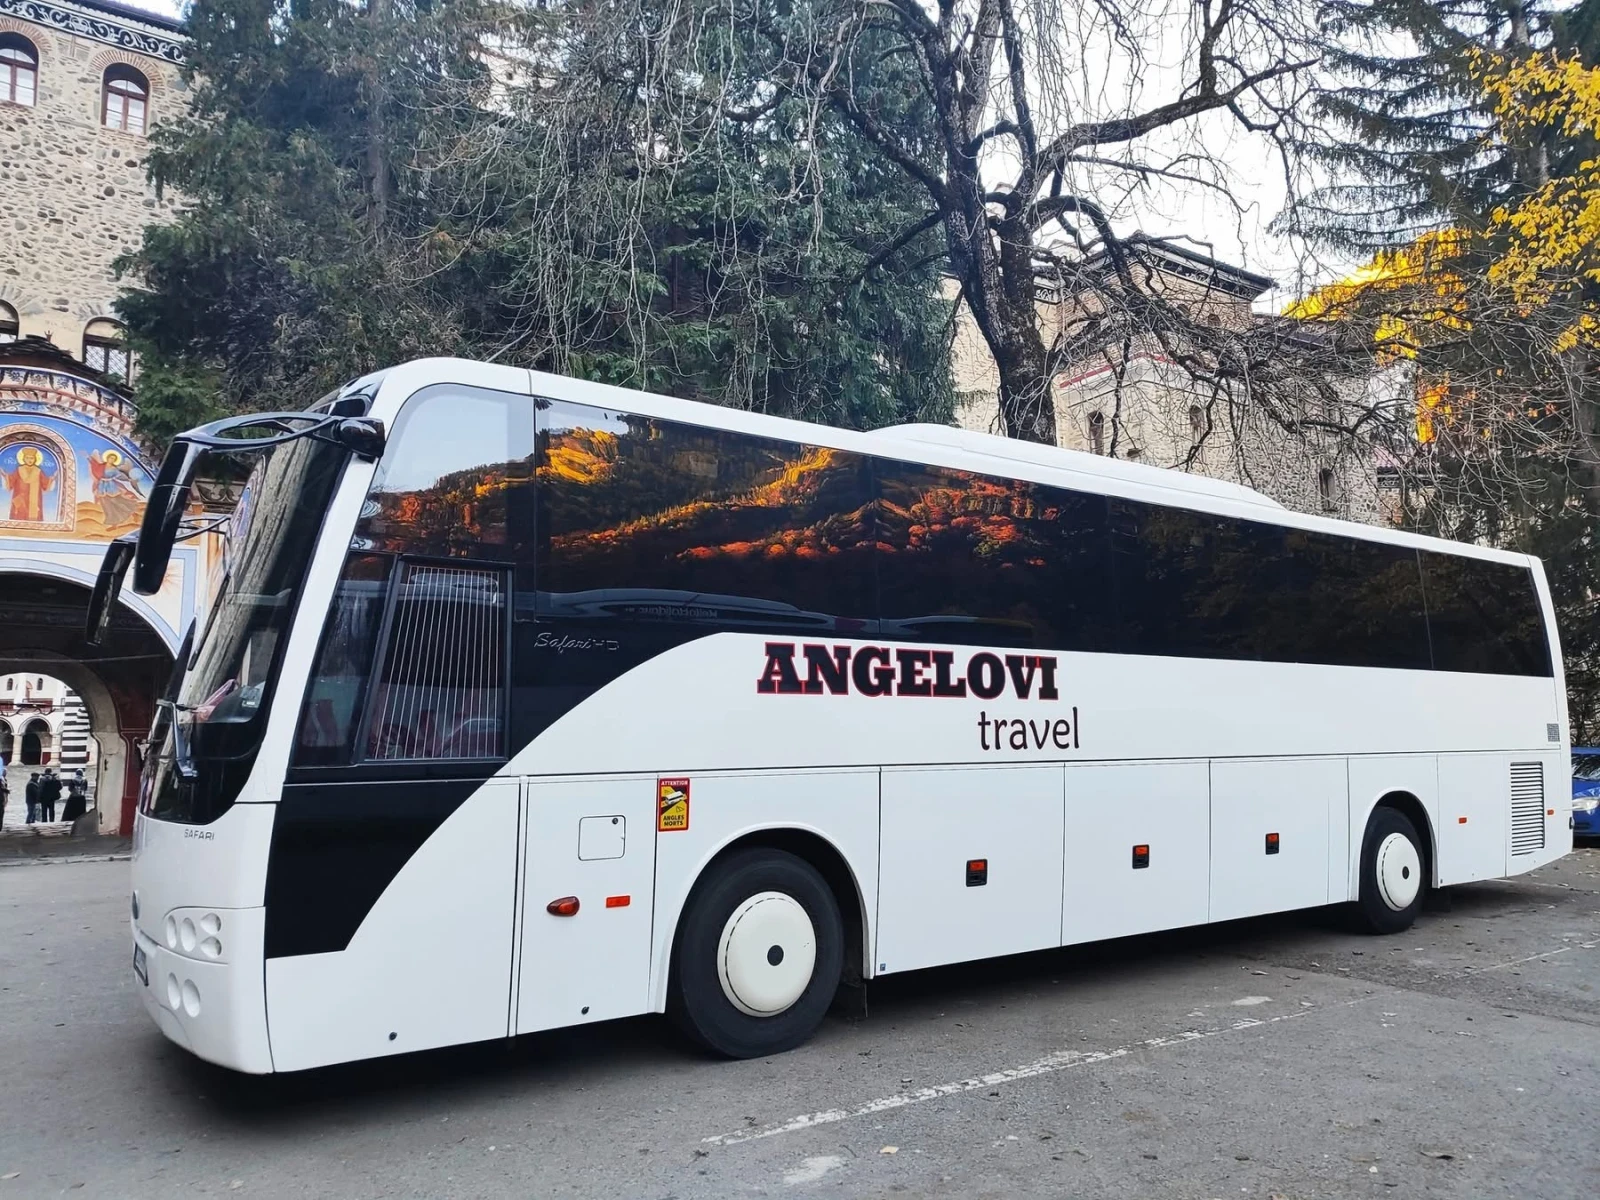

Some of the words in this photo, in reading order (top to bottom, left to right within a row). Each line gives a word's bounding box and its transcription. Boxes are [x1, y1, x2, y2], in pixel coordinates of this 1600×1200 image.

[534, 632, 591, 654] Safari
[757, 641, 1059, 701] ANGELOVI
[977, 706, 1080, 750] travel
[184, 828, 214, 840] SAFARI
